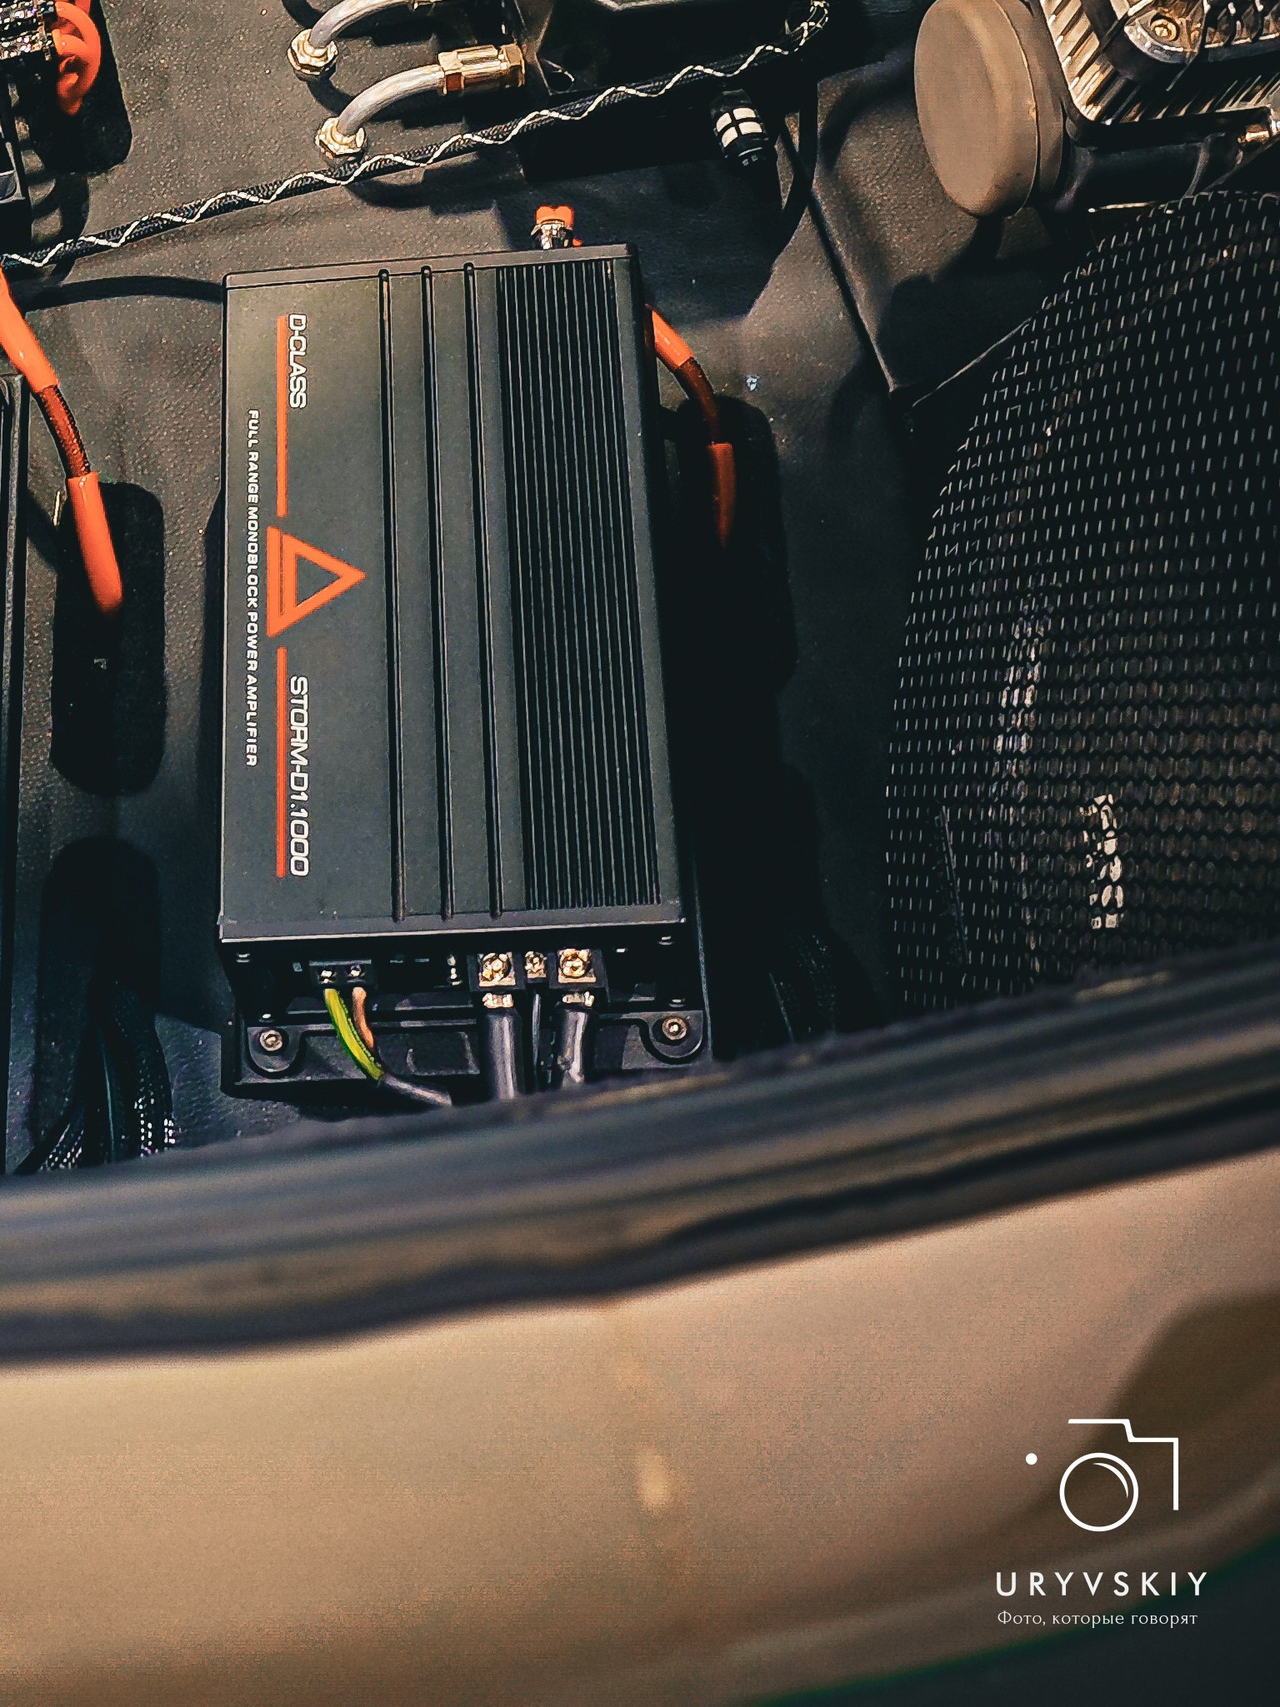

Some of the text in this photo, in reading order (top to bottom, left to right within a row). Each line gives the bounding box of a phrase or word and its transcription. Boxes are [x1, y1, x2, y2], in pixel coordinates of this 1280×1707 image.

[288, 314, 307, 409] D-CLASS
[245, 409, 260, 766] FULL RANGE MONOBLOCK POWER AMPLIFIER
[290, 675, 309, 877] STORM-D1.1000
